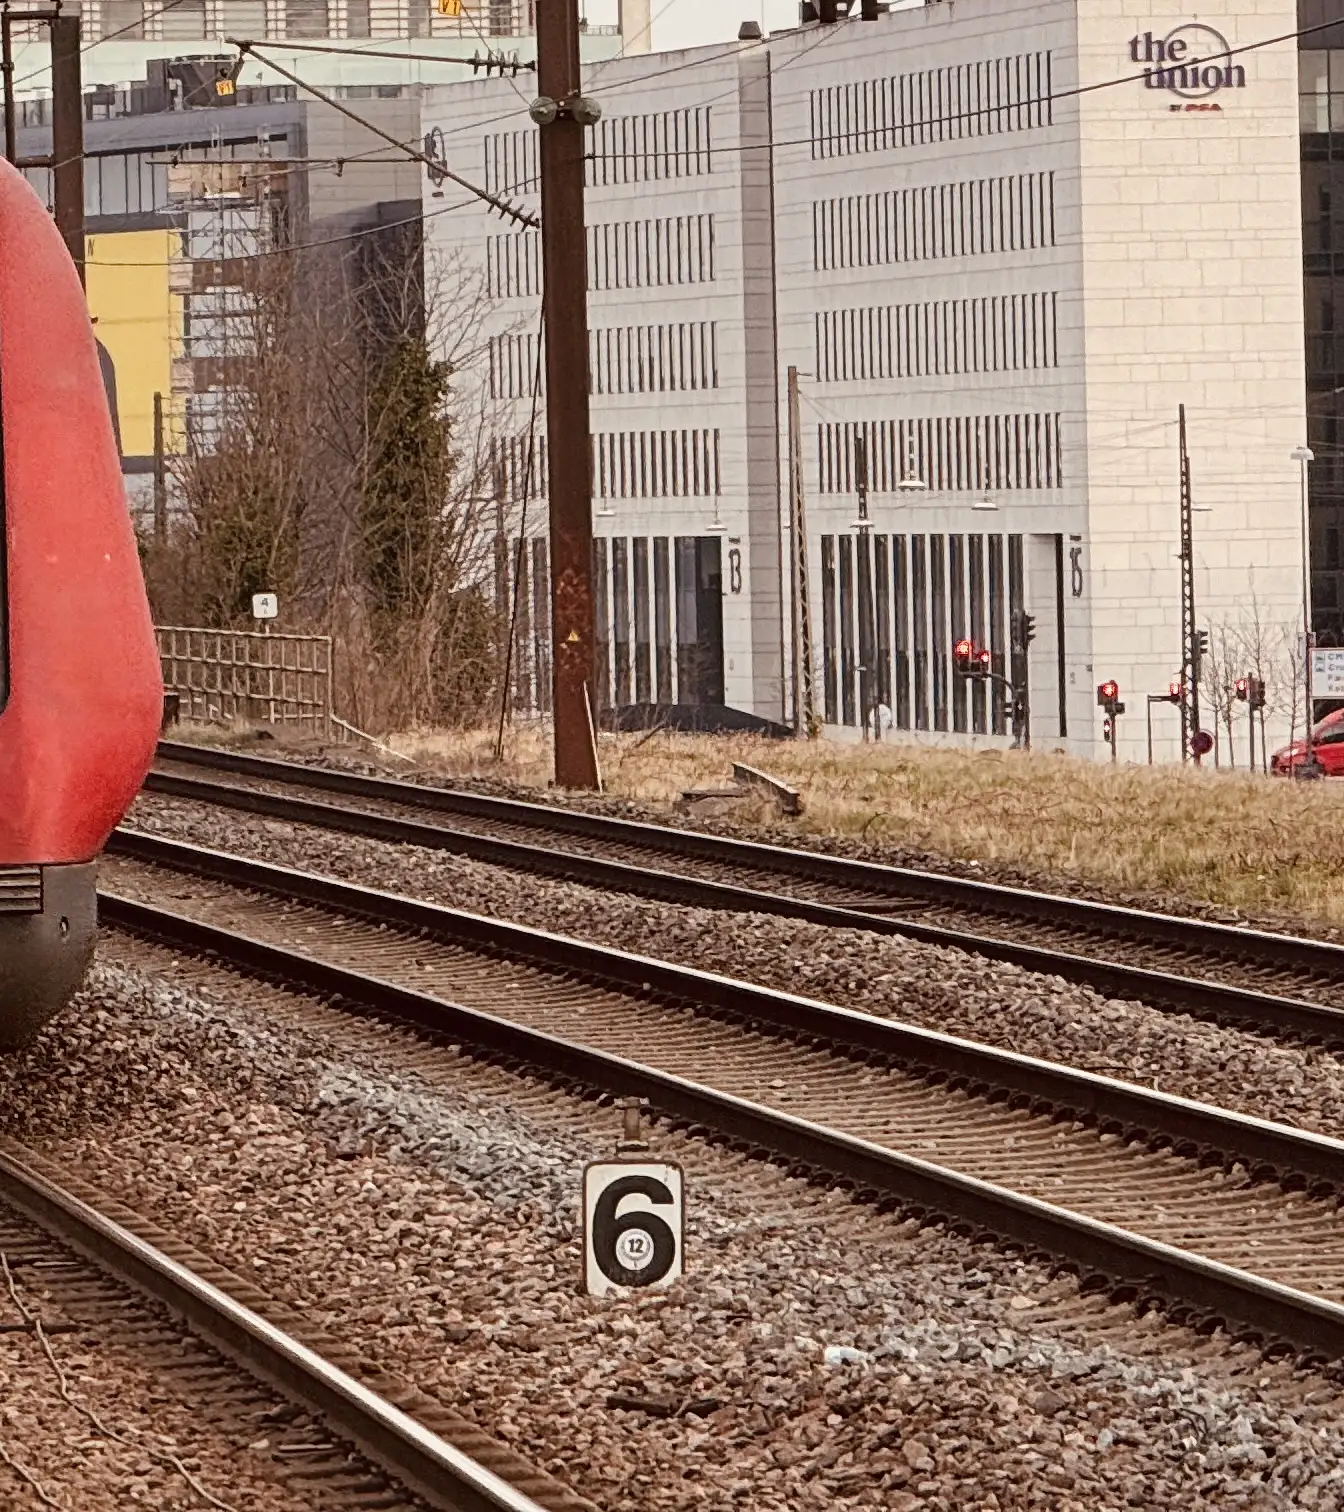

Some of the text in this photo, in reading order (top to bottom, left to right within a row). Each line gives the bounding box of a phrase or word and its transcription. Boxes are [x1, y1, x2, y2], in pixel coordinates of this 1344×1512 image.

[1128, 31, 1187, 62] the
[1144, 57, 1246, 89] union
[592, 1174, 676, 1287] 6
[627, 1238, 644, 1254] 12
